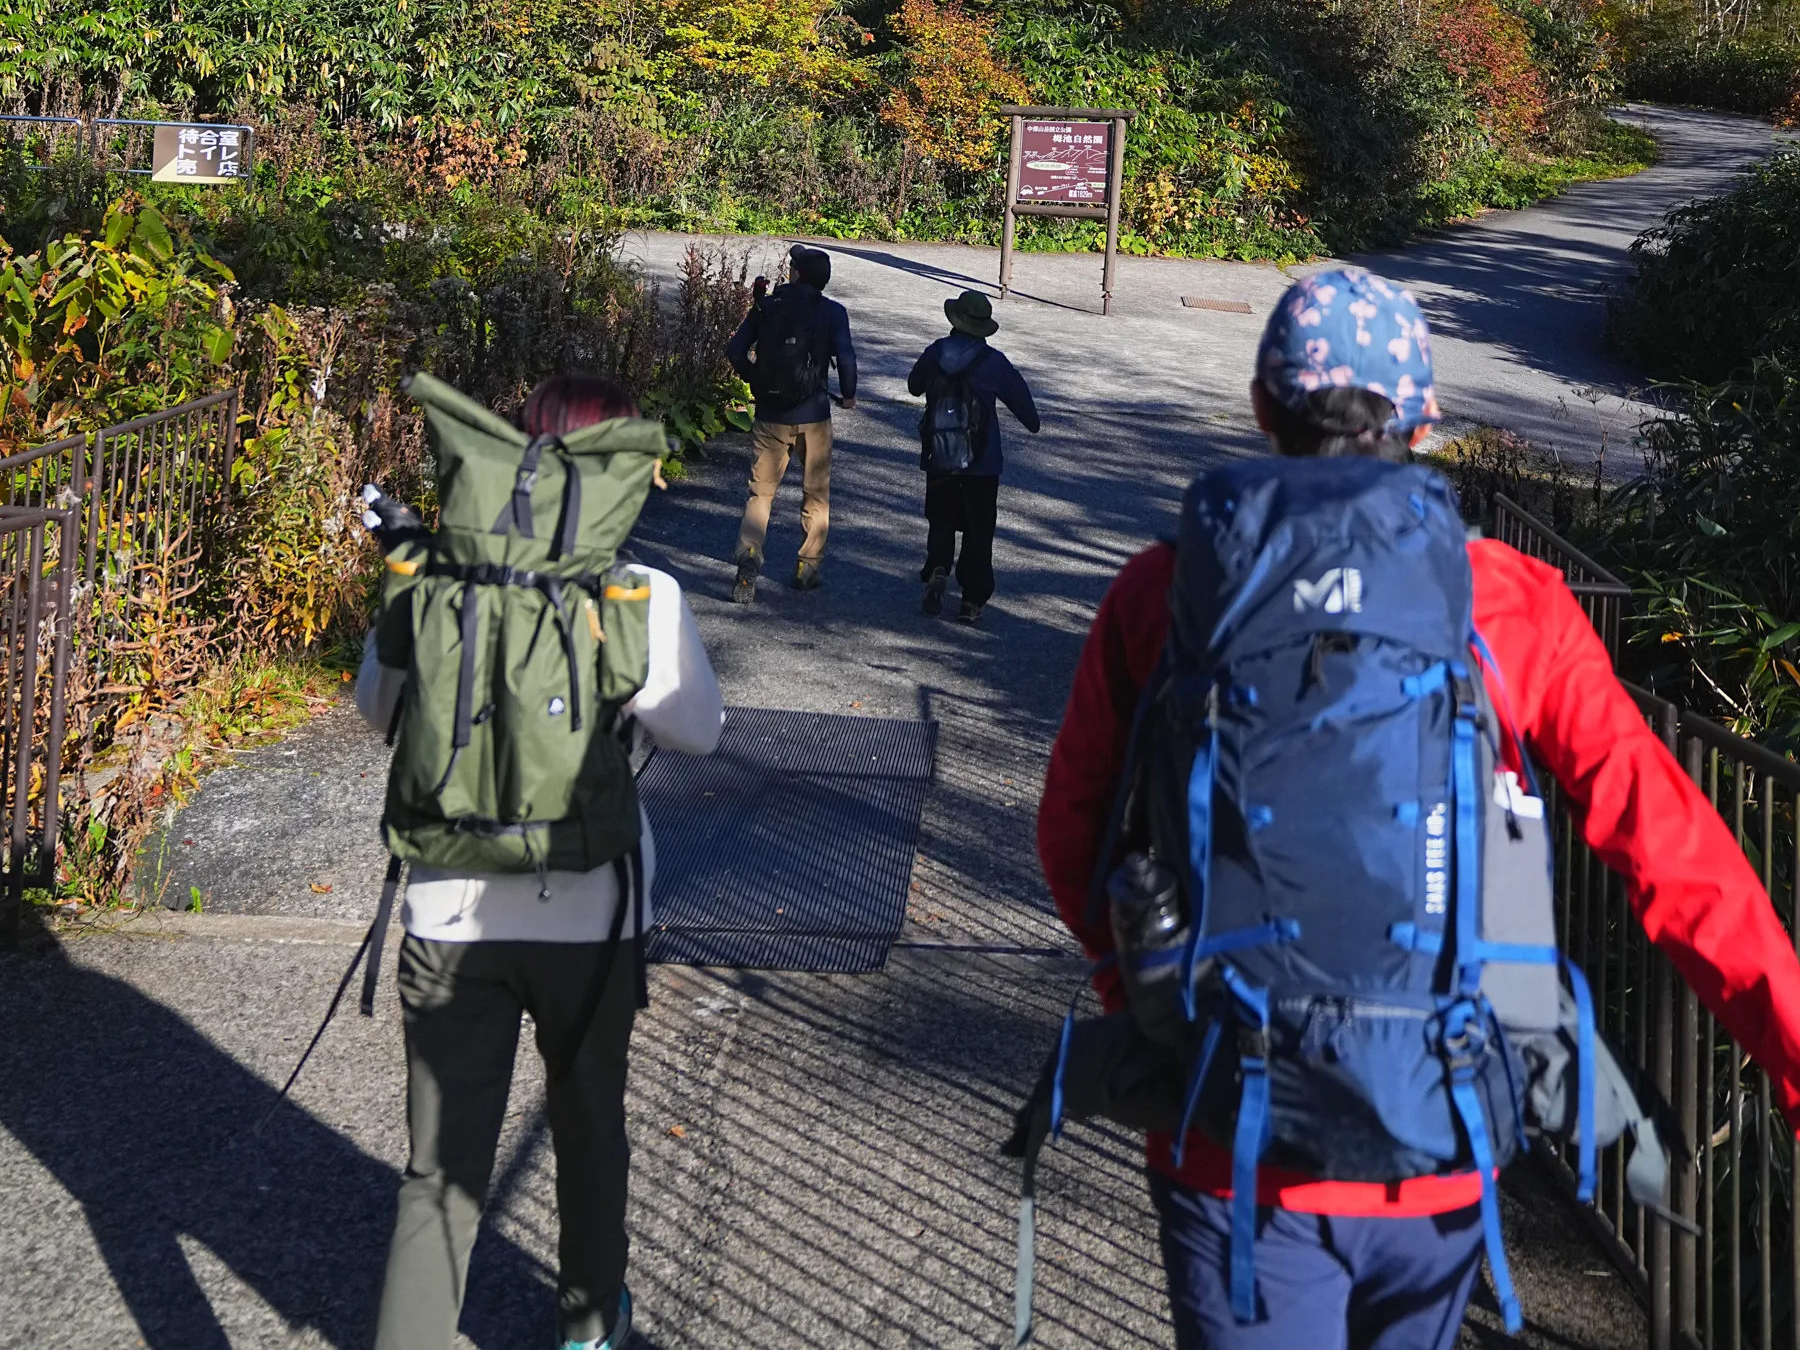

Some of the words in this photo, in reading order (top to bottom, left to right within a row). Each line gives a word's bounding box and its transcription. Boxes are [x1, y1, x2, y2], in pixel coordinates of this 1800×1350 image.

[178, 129, 239, 146] 待合室
[179, 144, 238, 161] トイレ
[177, 159, 239, 176] 売店
